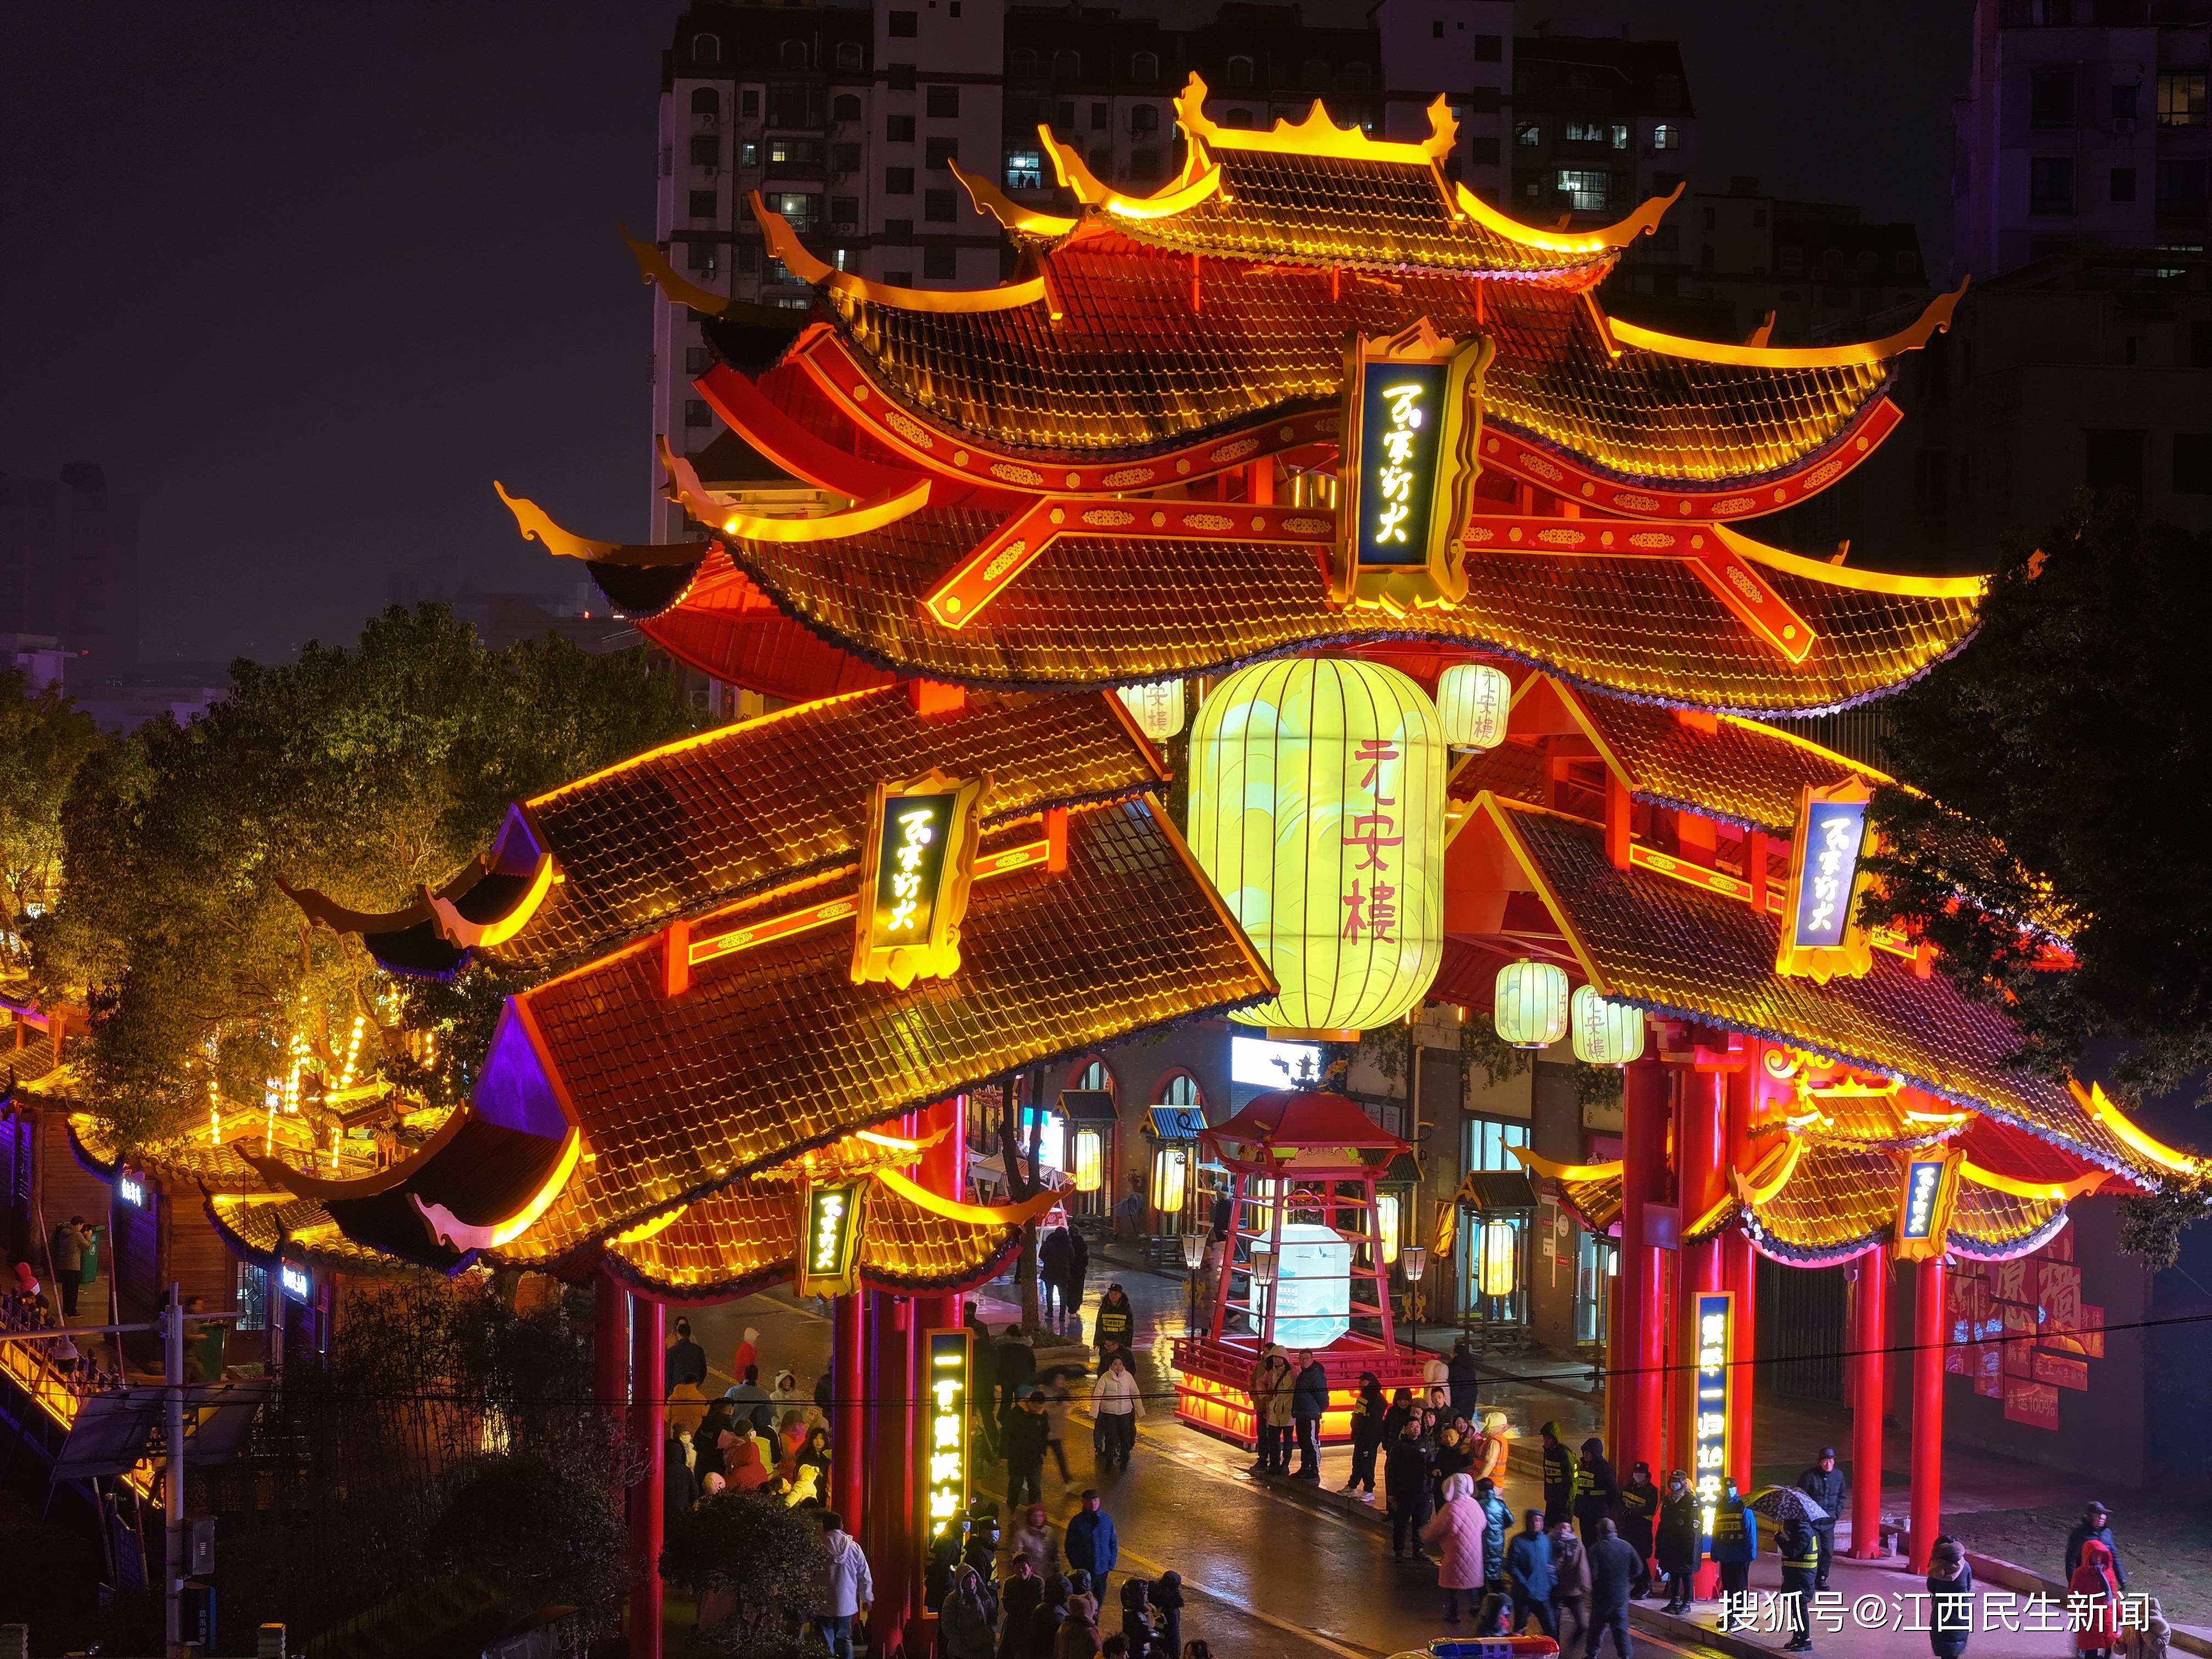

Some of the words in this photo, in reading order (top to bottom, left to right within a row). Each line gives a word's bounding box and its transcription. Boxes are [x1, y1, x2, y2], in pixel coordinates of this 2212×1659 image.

[1473, 670, 1497, 739] 元安樓
[1342, 739, 1403, 945] 元安樓
